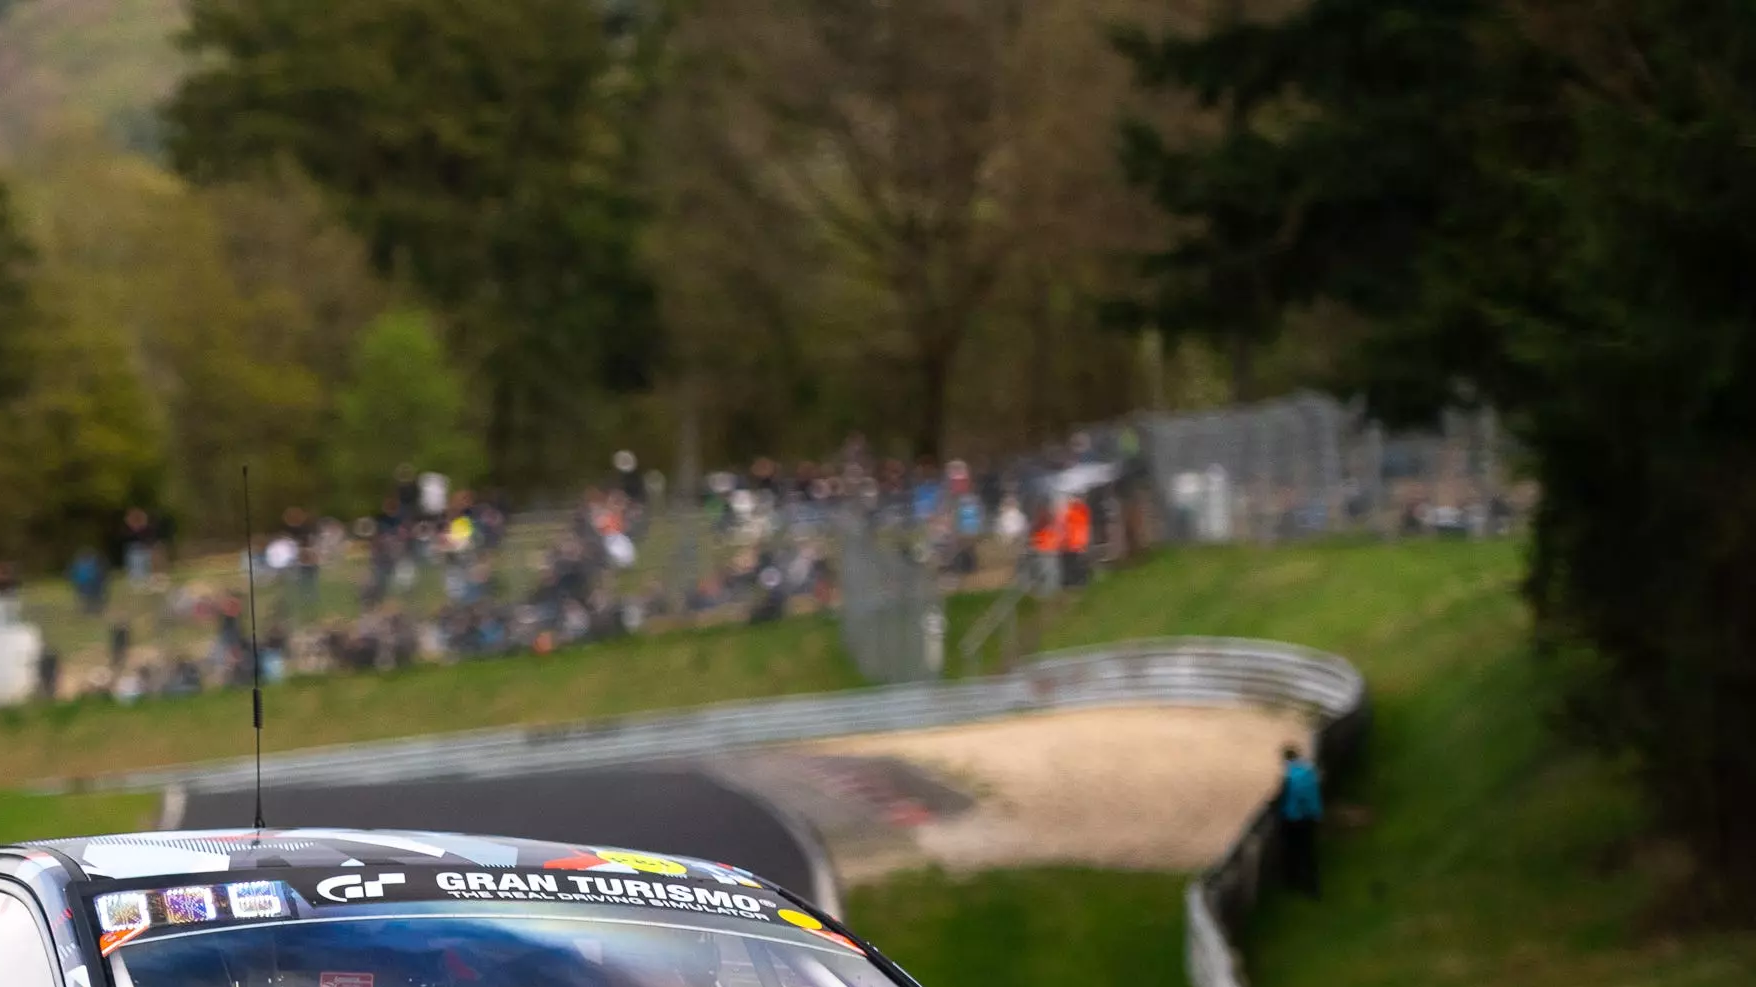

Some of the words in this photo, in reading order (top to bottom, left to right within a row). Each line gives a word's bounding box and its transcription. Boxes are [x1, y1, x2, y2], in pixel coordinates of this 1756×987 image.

[435, 871, 559, 893] GRAN
[447, 890, 494, 900] THE
[497, 890, 556, 901] REAL
[557, 892, 646, 906] DRIVING
[649, 897, 770, 922] SIMULATOR
